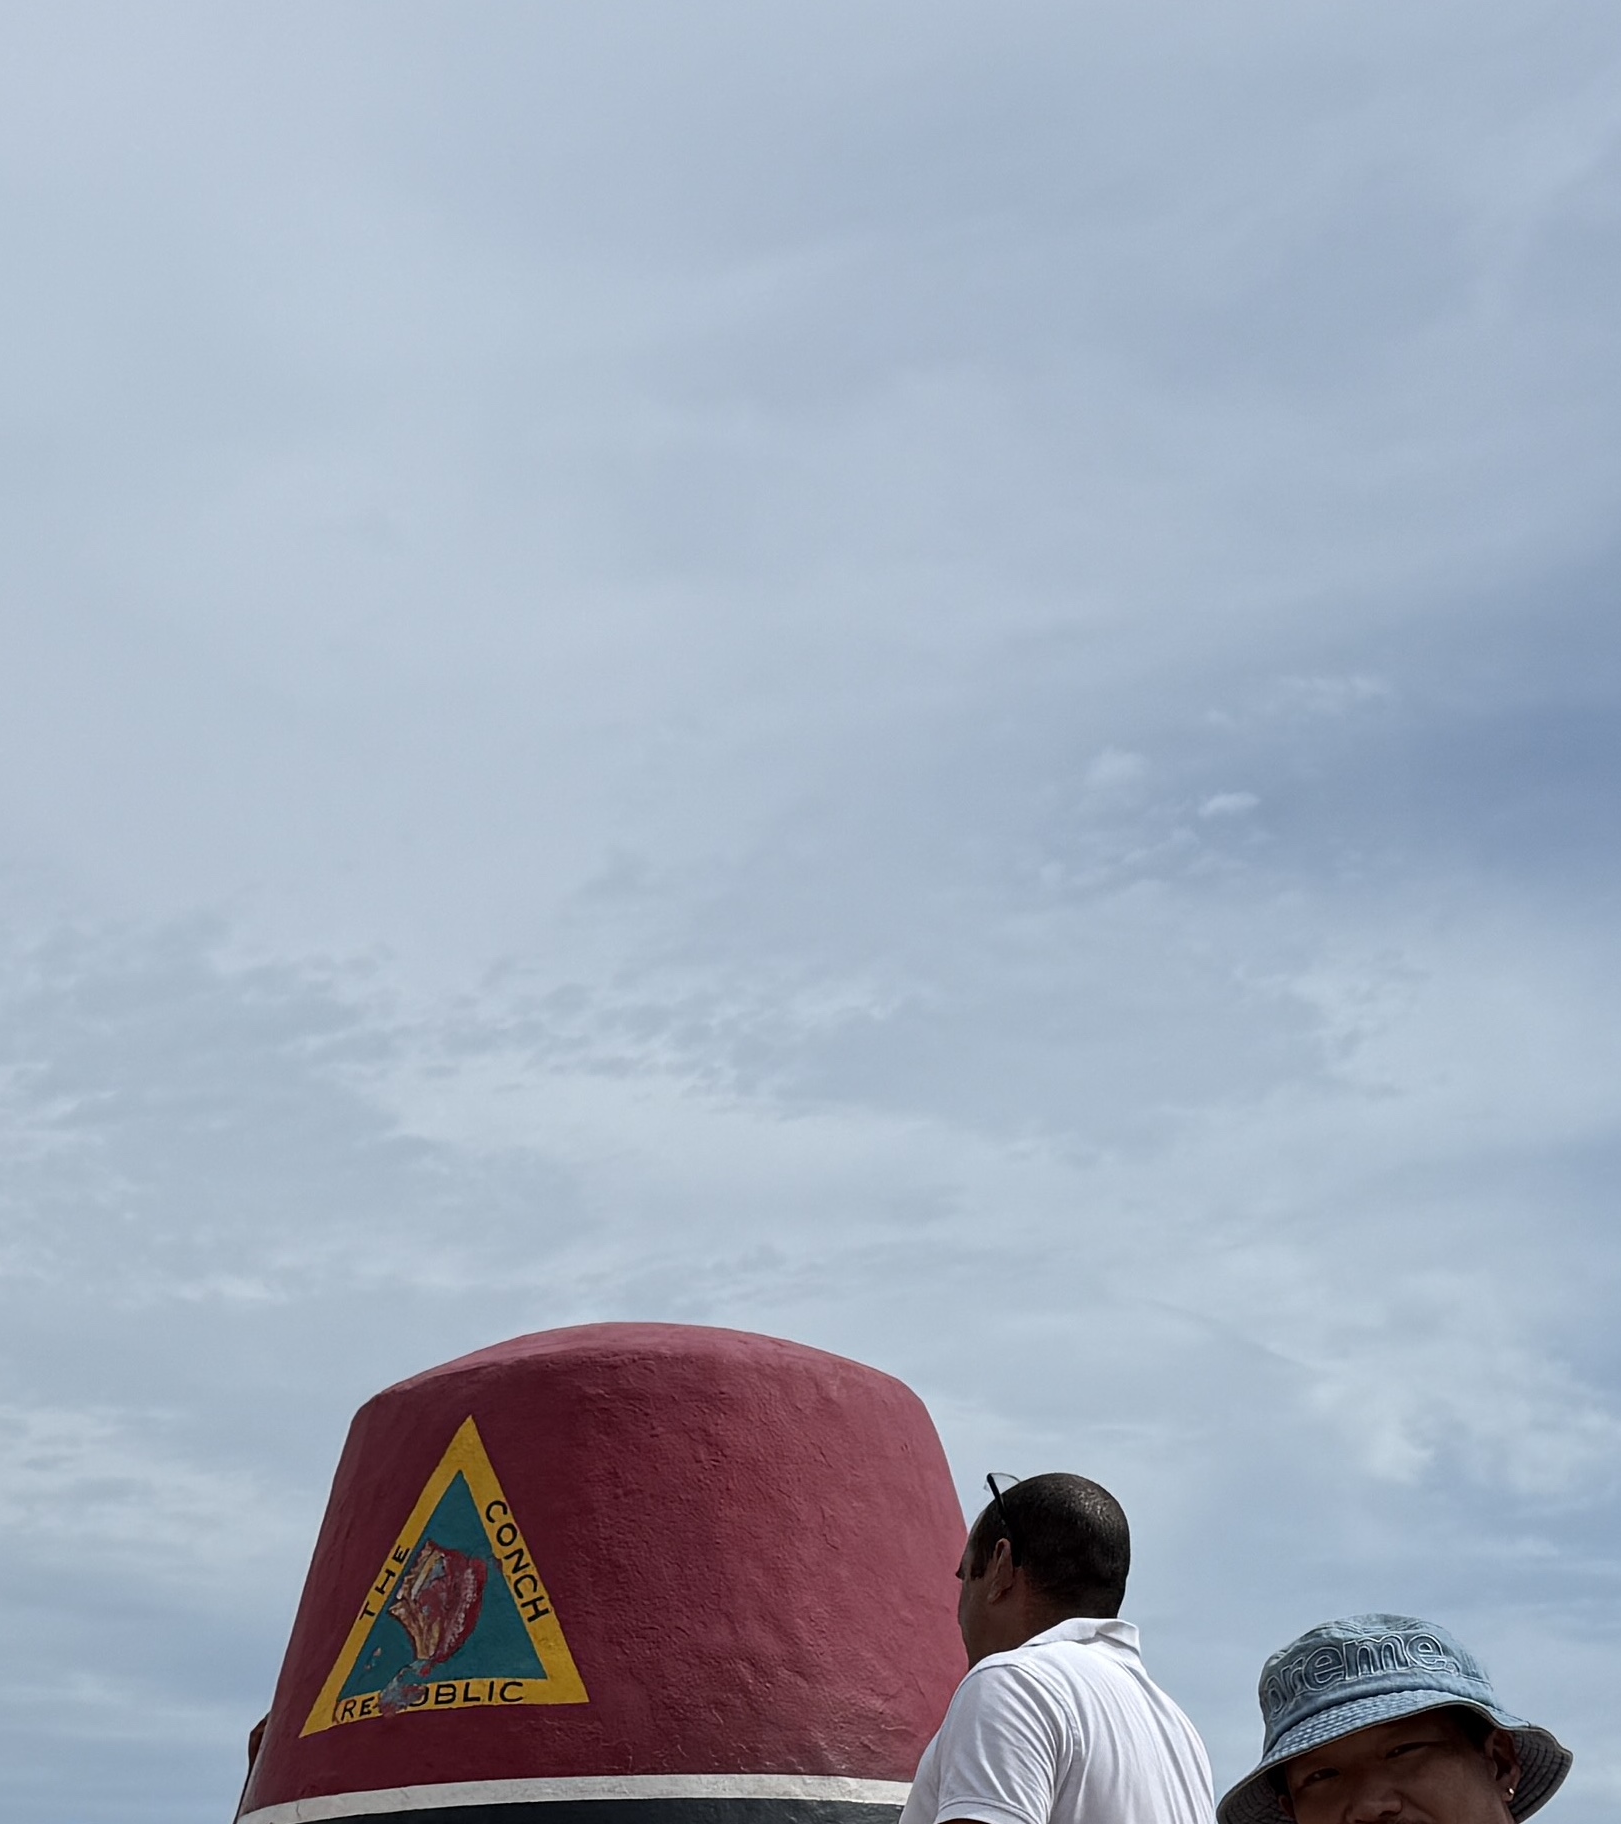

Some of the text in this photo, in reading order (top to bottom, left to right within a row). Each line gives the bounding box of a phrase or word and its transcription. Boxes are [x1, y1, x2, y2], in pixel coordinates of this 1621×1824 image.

[358, 1545, 411, 1621] THE
[485, 1500, 551, 1624] CONCH
[340, 1681, 524, 1722] REUBLIC
